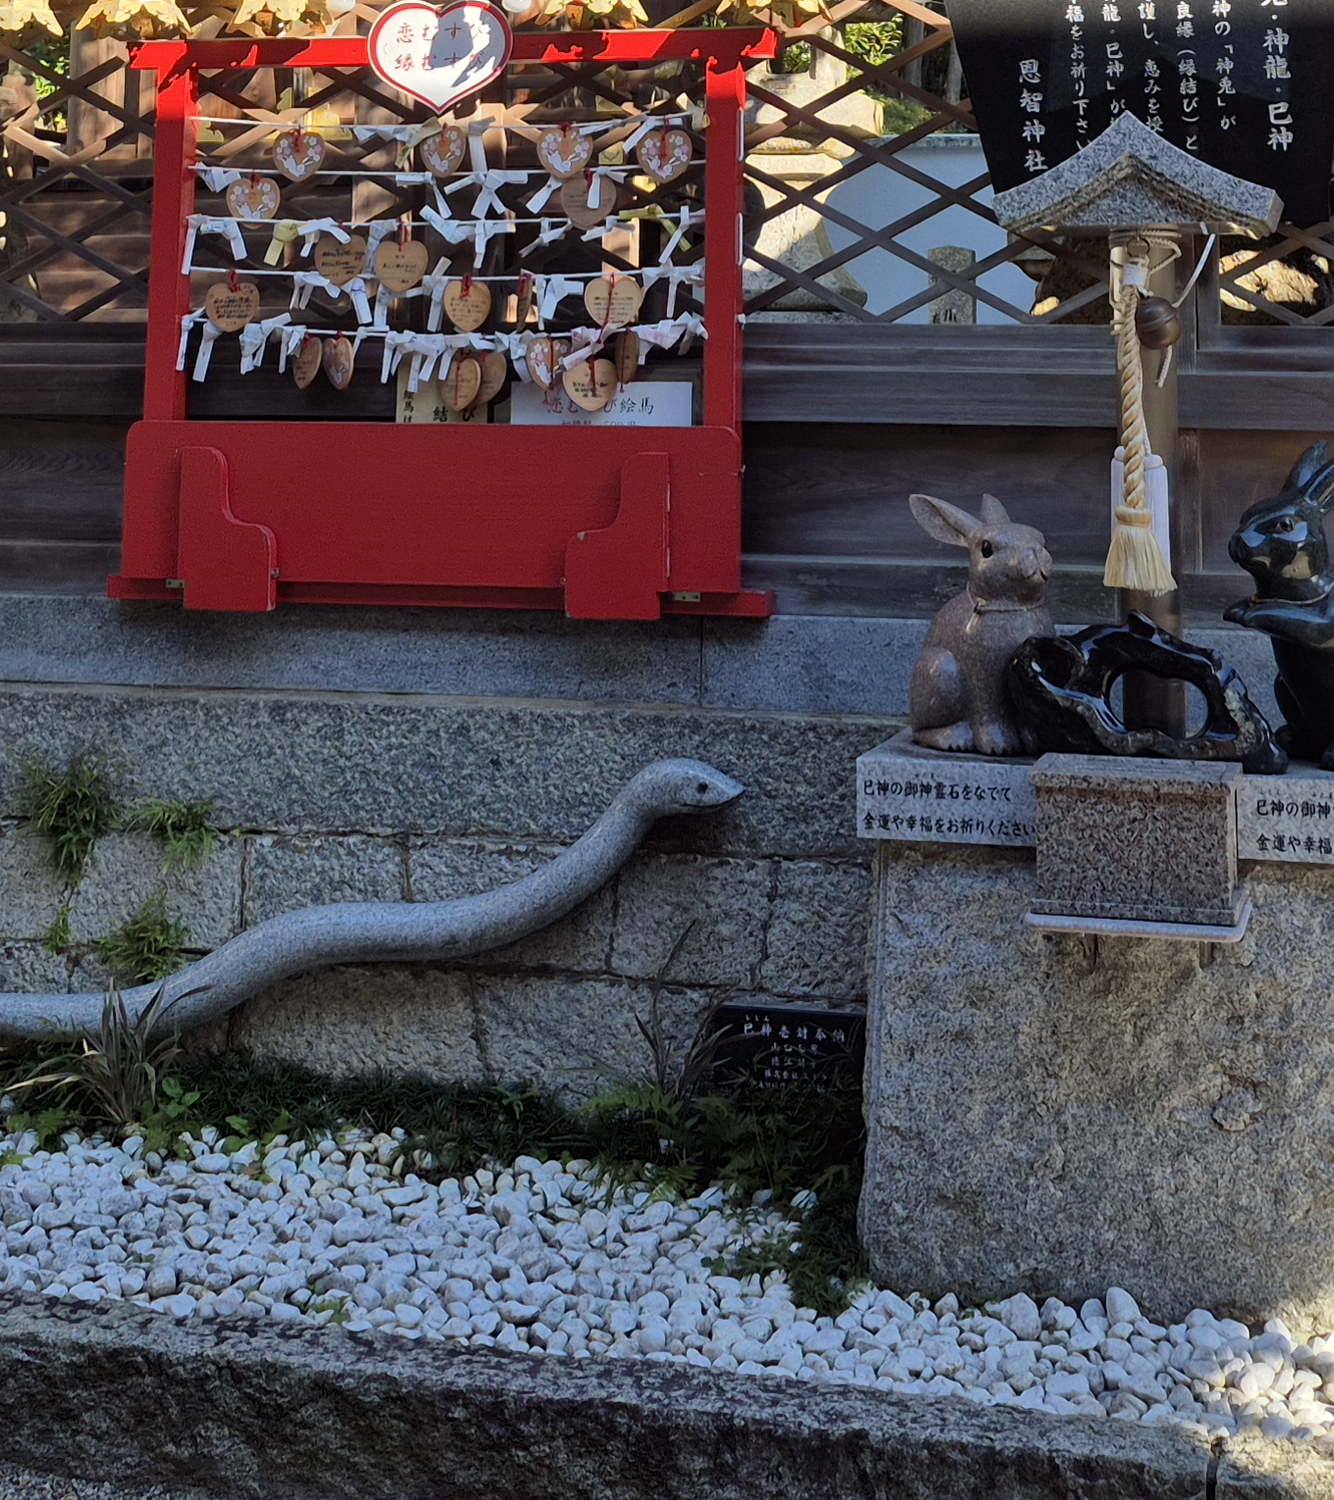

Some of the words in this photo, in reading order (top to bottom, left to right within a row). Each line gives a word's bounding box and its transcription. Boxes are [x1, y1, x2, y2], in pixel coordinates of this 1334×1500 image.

[396, 22, 485, 45] 恋むすび
[394, 51, 485, 72] 縁むすび
[1018, 59, 1048, 173] 恩智神社
[547, 396, 655, 416] 恋むび絵馬
